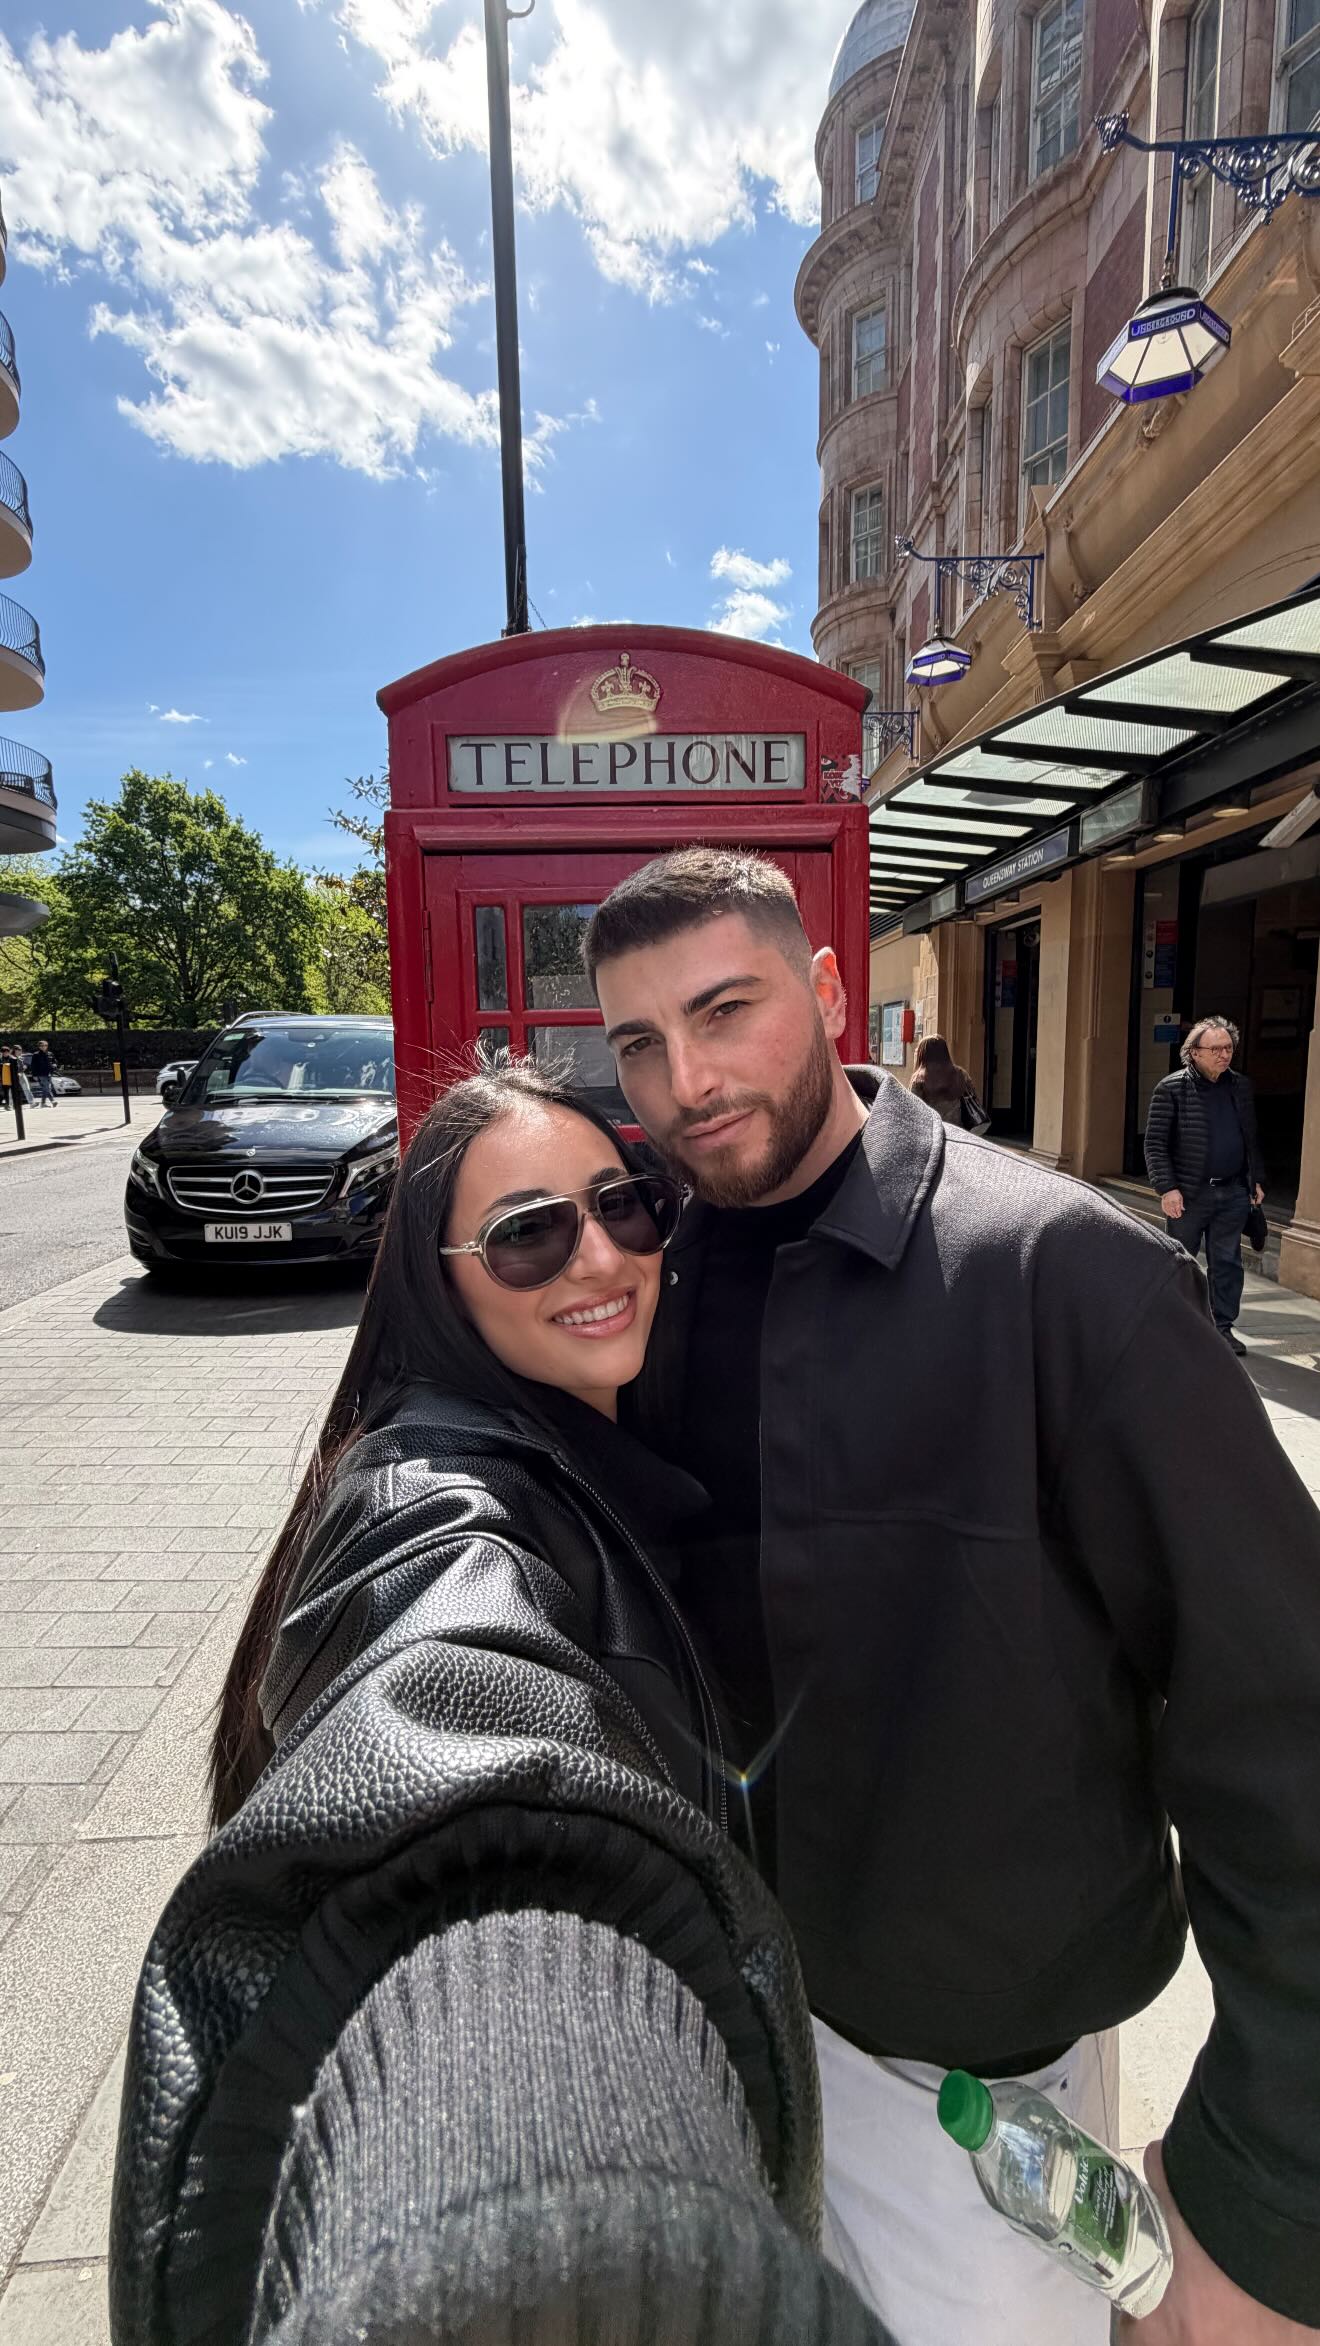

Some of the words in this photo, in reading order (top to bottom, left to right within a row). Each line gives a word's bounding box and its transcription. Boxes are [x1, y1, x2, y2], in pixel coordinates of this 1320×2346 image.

[1131, 308, 1196, 337] UNDERGROUND
[459, 740, 794, 785] TELEPHONE
[982, 862, 1017, 889] QUEENSWAY
[1017, 848, 1044, 873] STATION
[214, 1226, 249, 1240] KU19
[253, 1225, 283, 1239] JJK
[1073, 2156, 1089, 2205] Volvic
